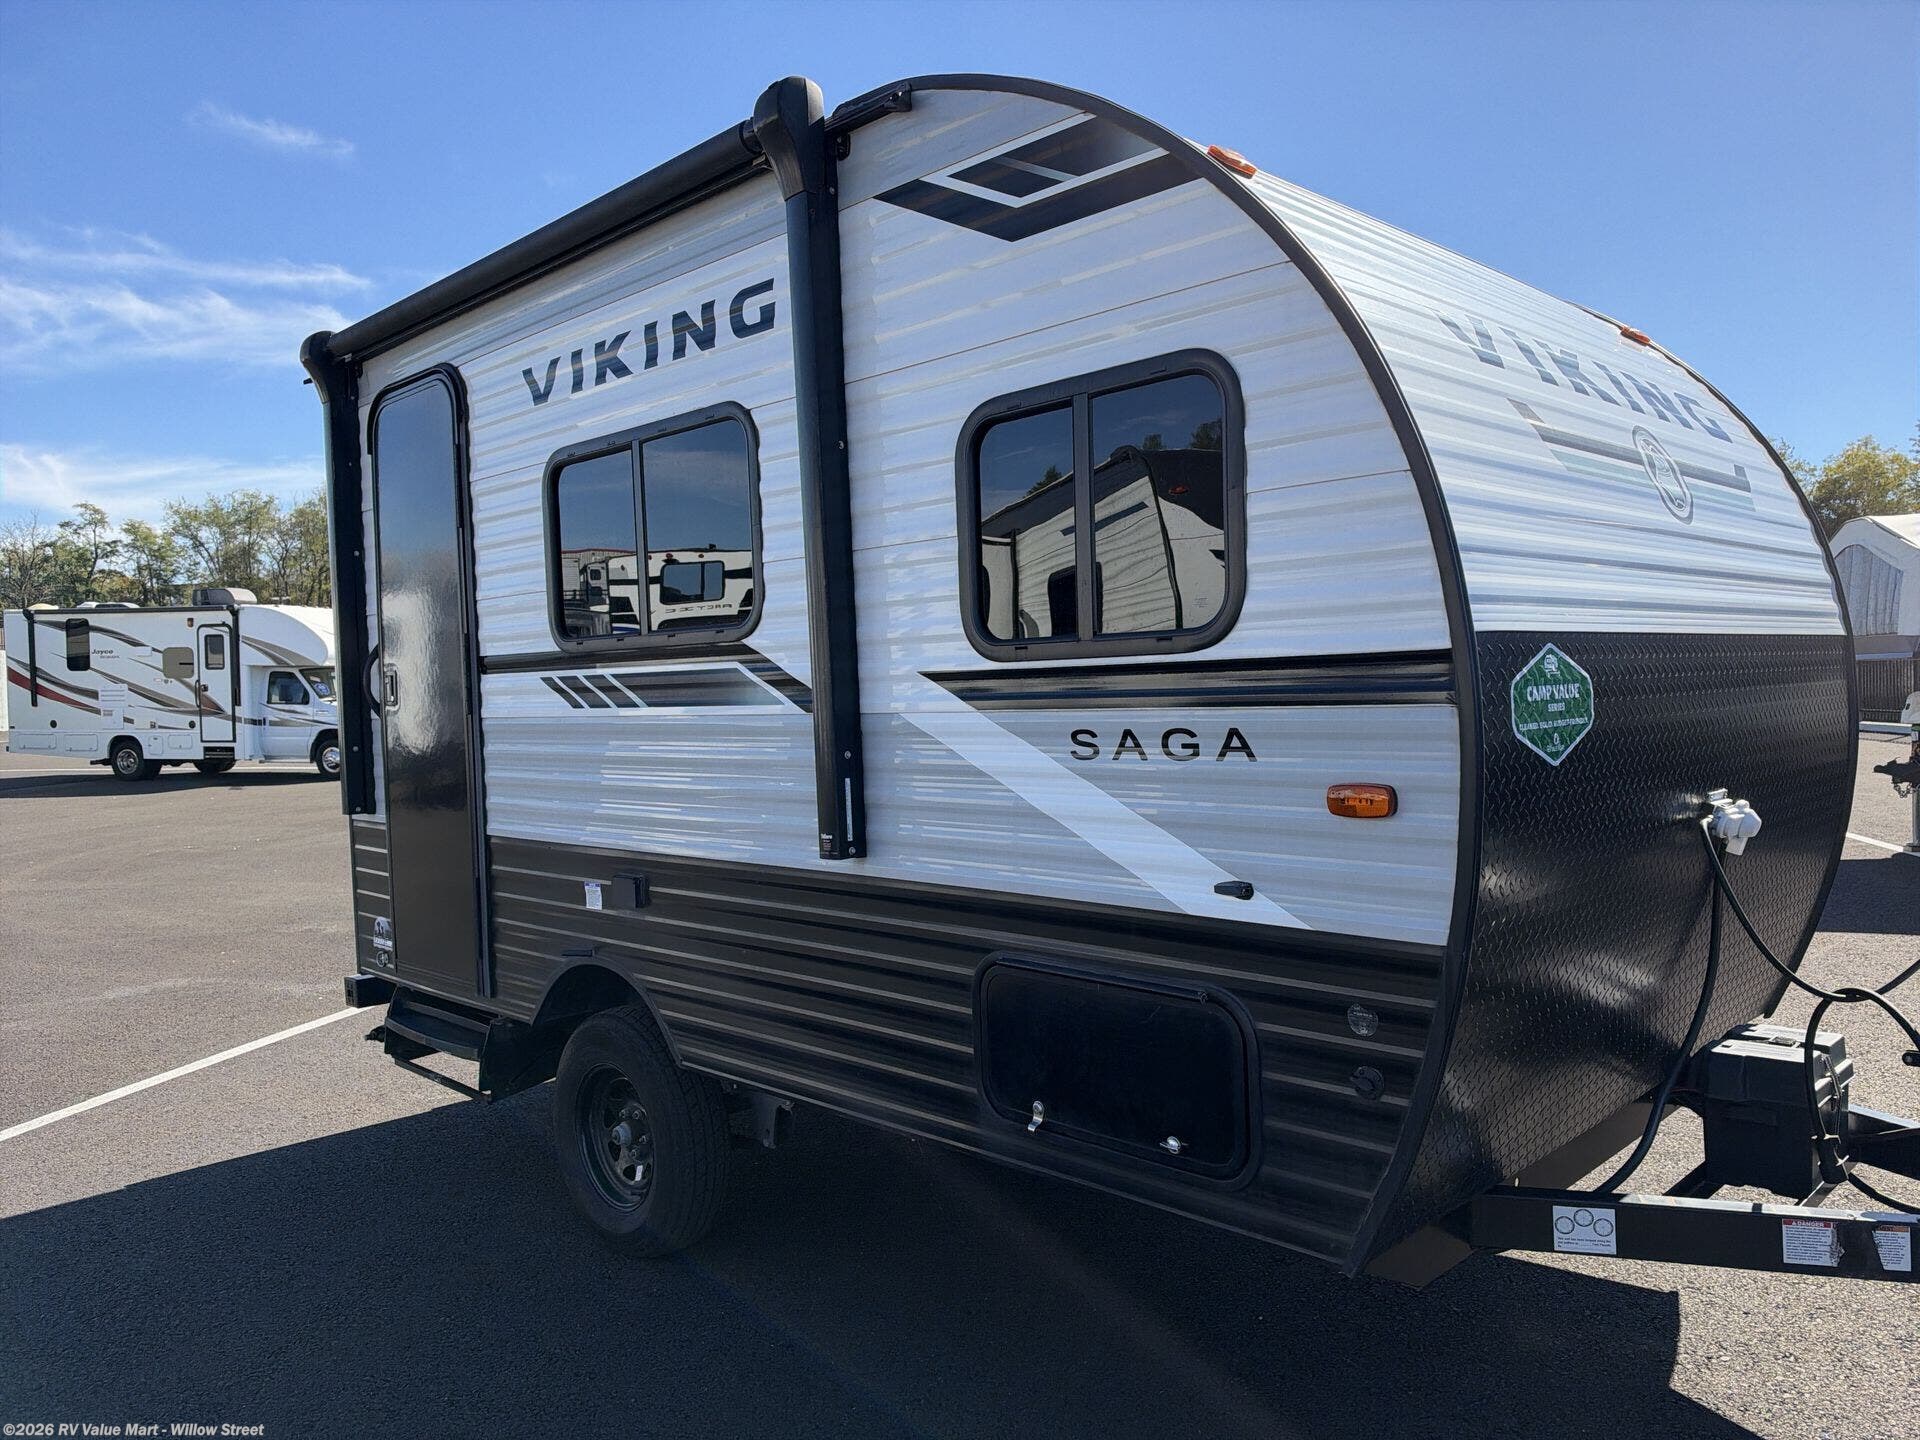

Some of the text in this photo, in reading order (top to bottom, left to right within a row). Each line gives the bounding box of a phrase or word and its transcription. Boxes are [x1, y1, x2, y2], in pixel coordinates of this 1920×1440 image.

[522, 277, 776, 406] VIKING
[1430, 308, 1733, 443] VIKING
[1527, 683, 1580, 702] CAMP VALUE
[1547, 702, 1566, 712] SERIES
[1070, 727, 1258, 762] SAGA
[1797, 1220, 1824, 1228] DANGER
